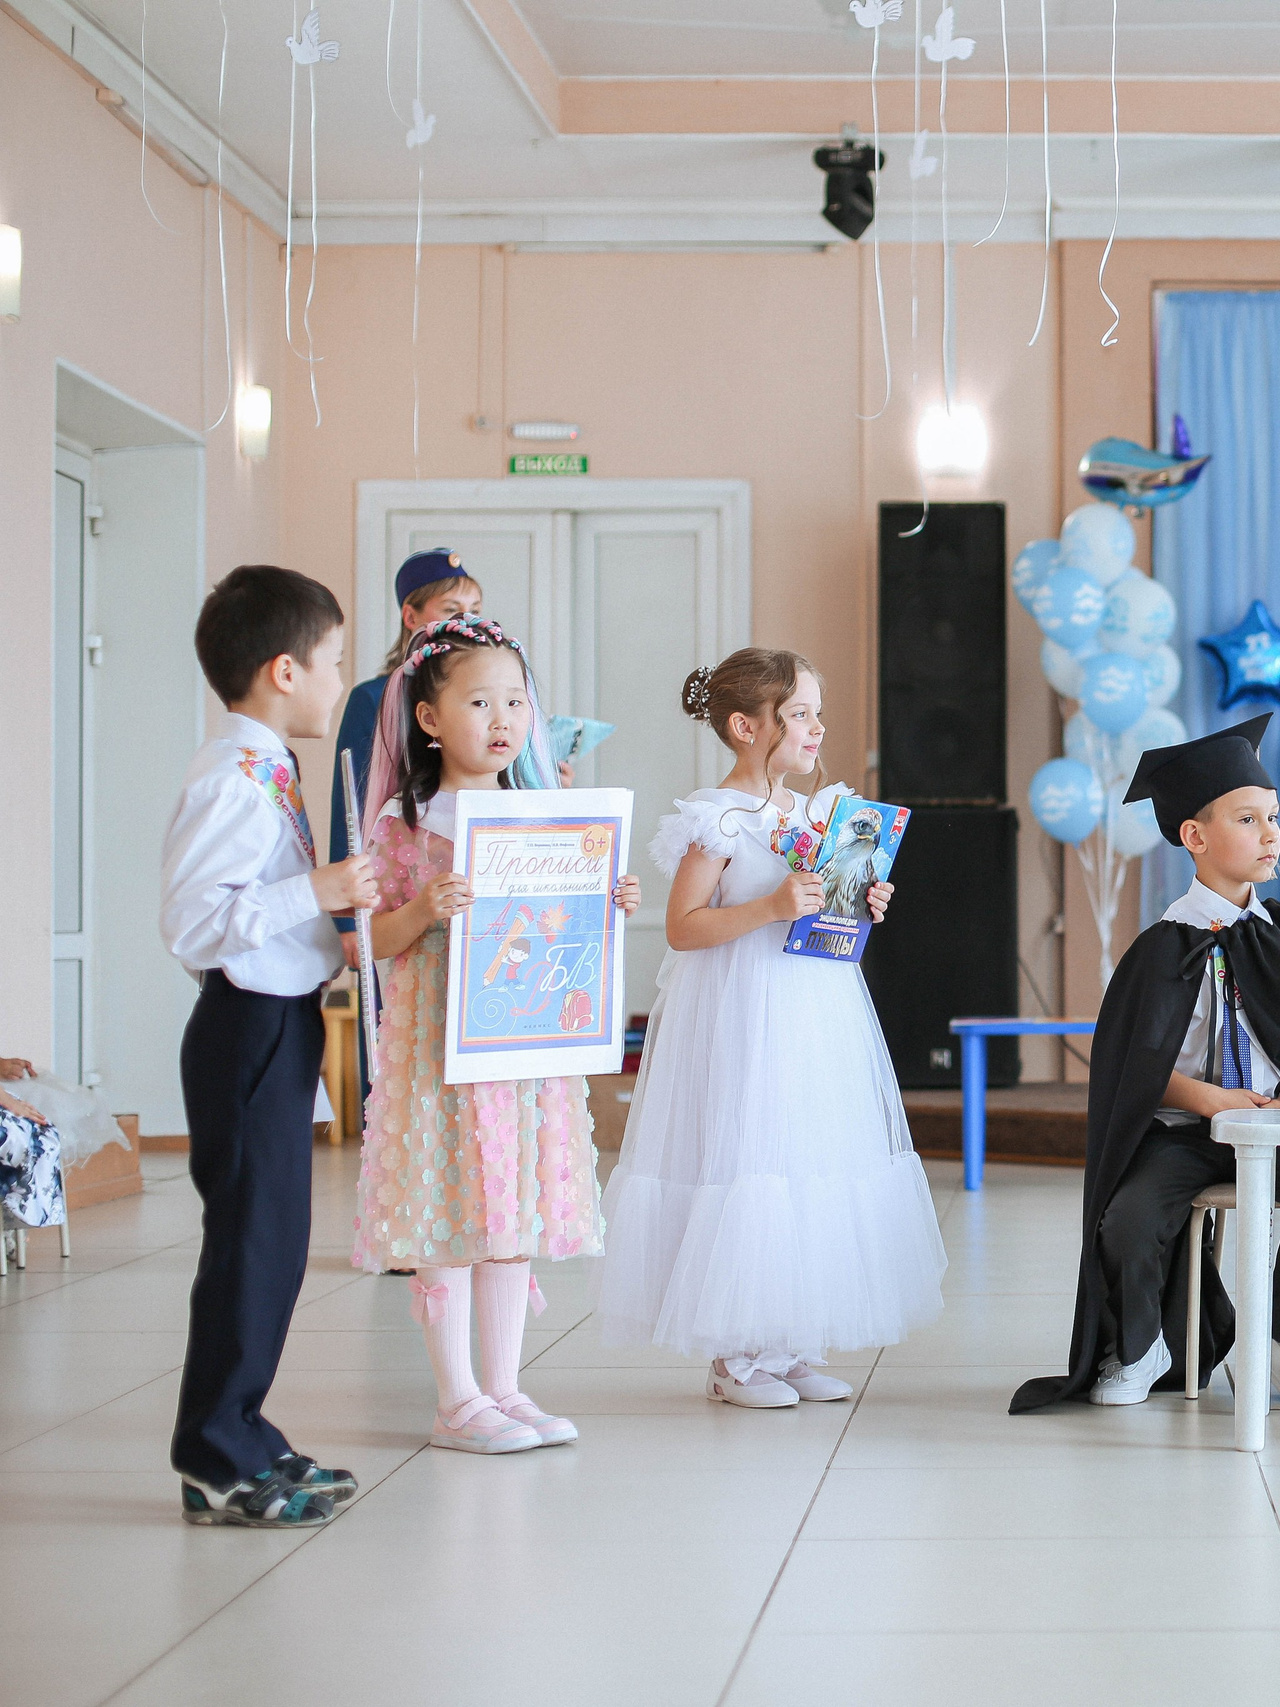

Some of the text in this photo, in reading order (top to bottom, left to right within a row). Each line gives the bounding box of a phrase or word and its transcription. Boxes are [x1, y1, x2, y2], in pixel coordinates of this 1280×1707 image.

[583, 831, 606, 852] 6+
[477, 840, 604, 890] Прописи
[507, 876, 602, 898] для школьников
[804, 930, 857, 958] ПТИЦЫ
